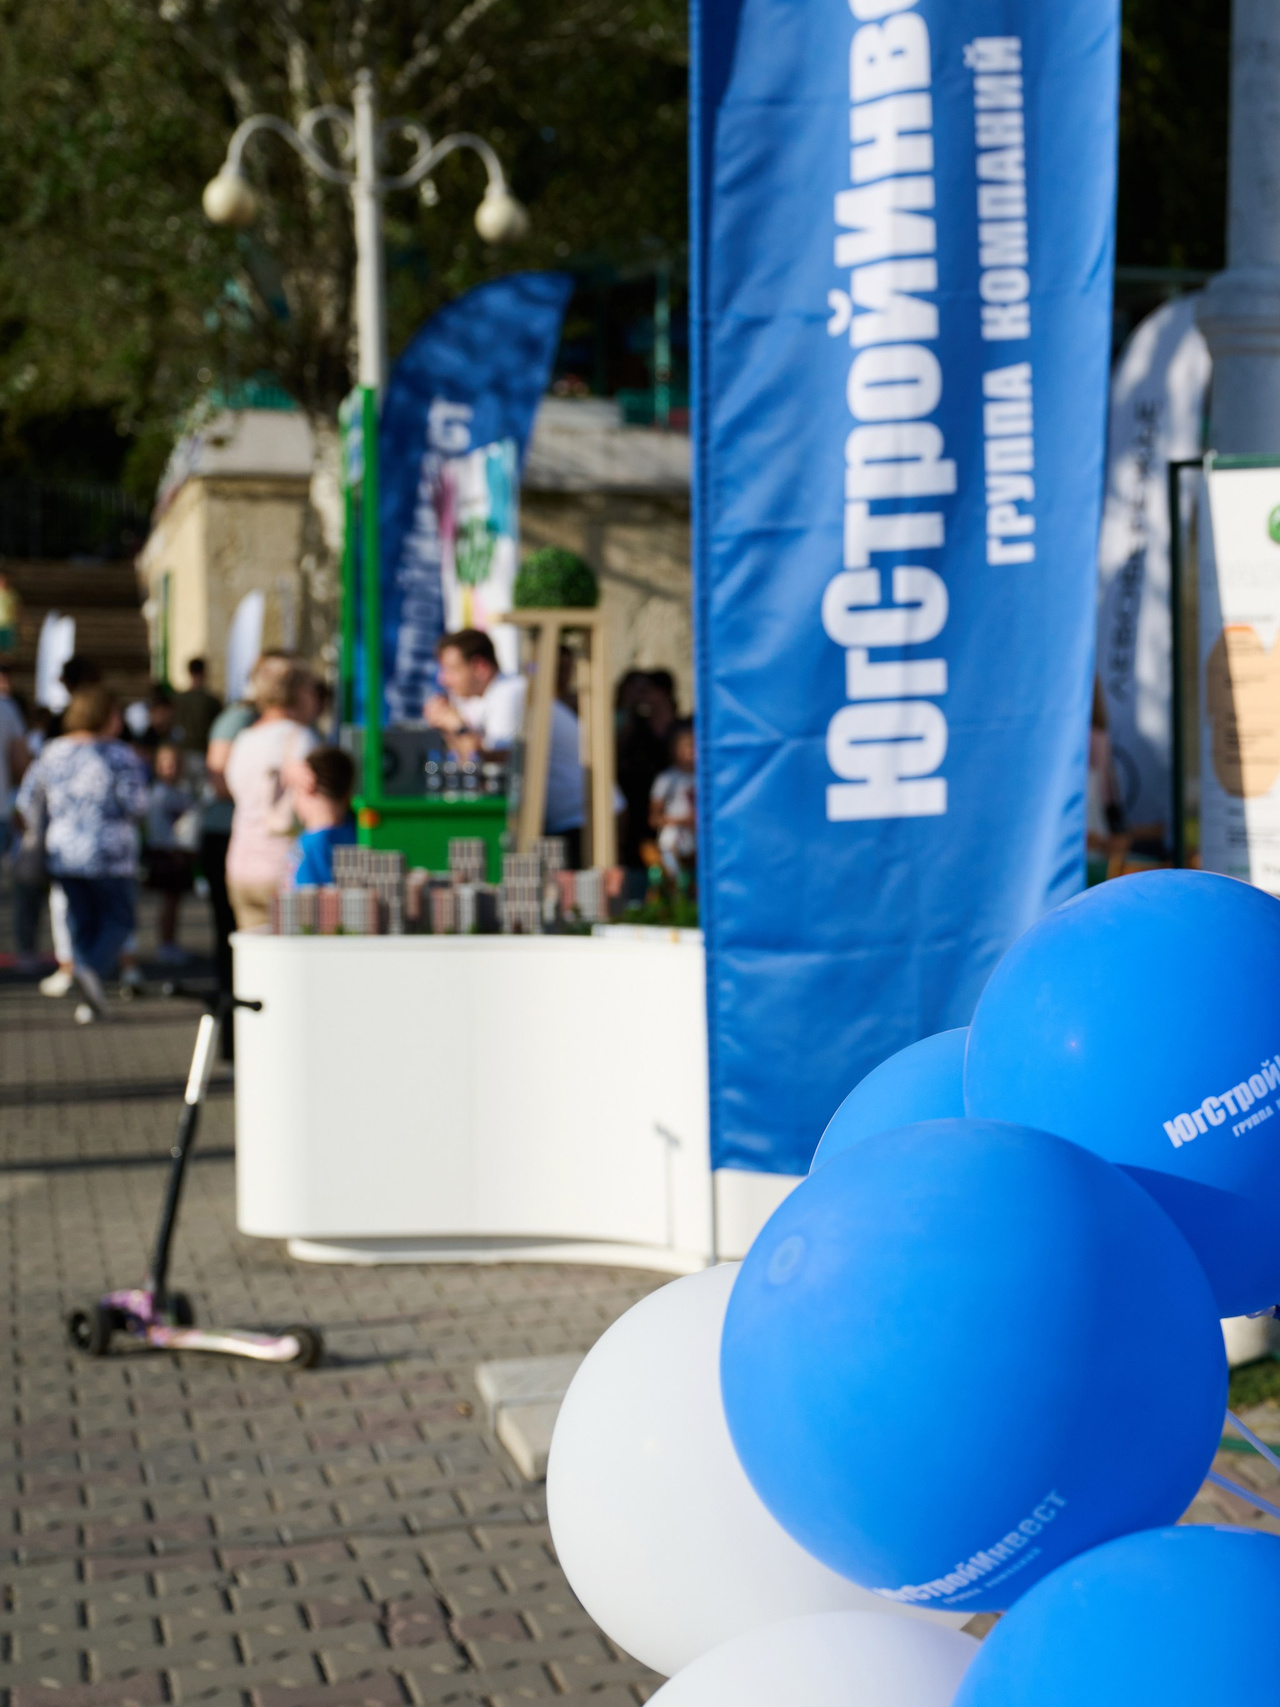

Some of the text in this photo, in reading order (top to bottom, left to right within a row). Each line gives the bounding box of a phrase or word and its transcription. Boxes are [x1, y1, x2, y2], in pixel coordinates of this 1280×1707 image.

[822, 0, 957, 822] ЮгСтройИнв
[963, 35, 1036, 567] ГРУППА КОМПАНИЙ
[1232, 1105, 1275, 1137] ГРУППА
